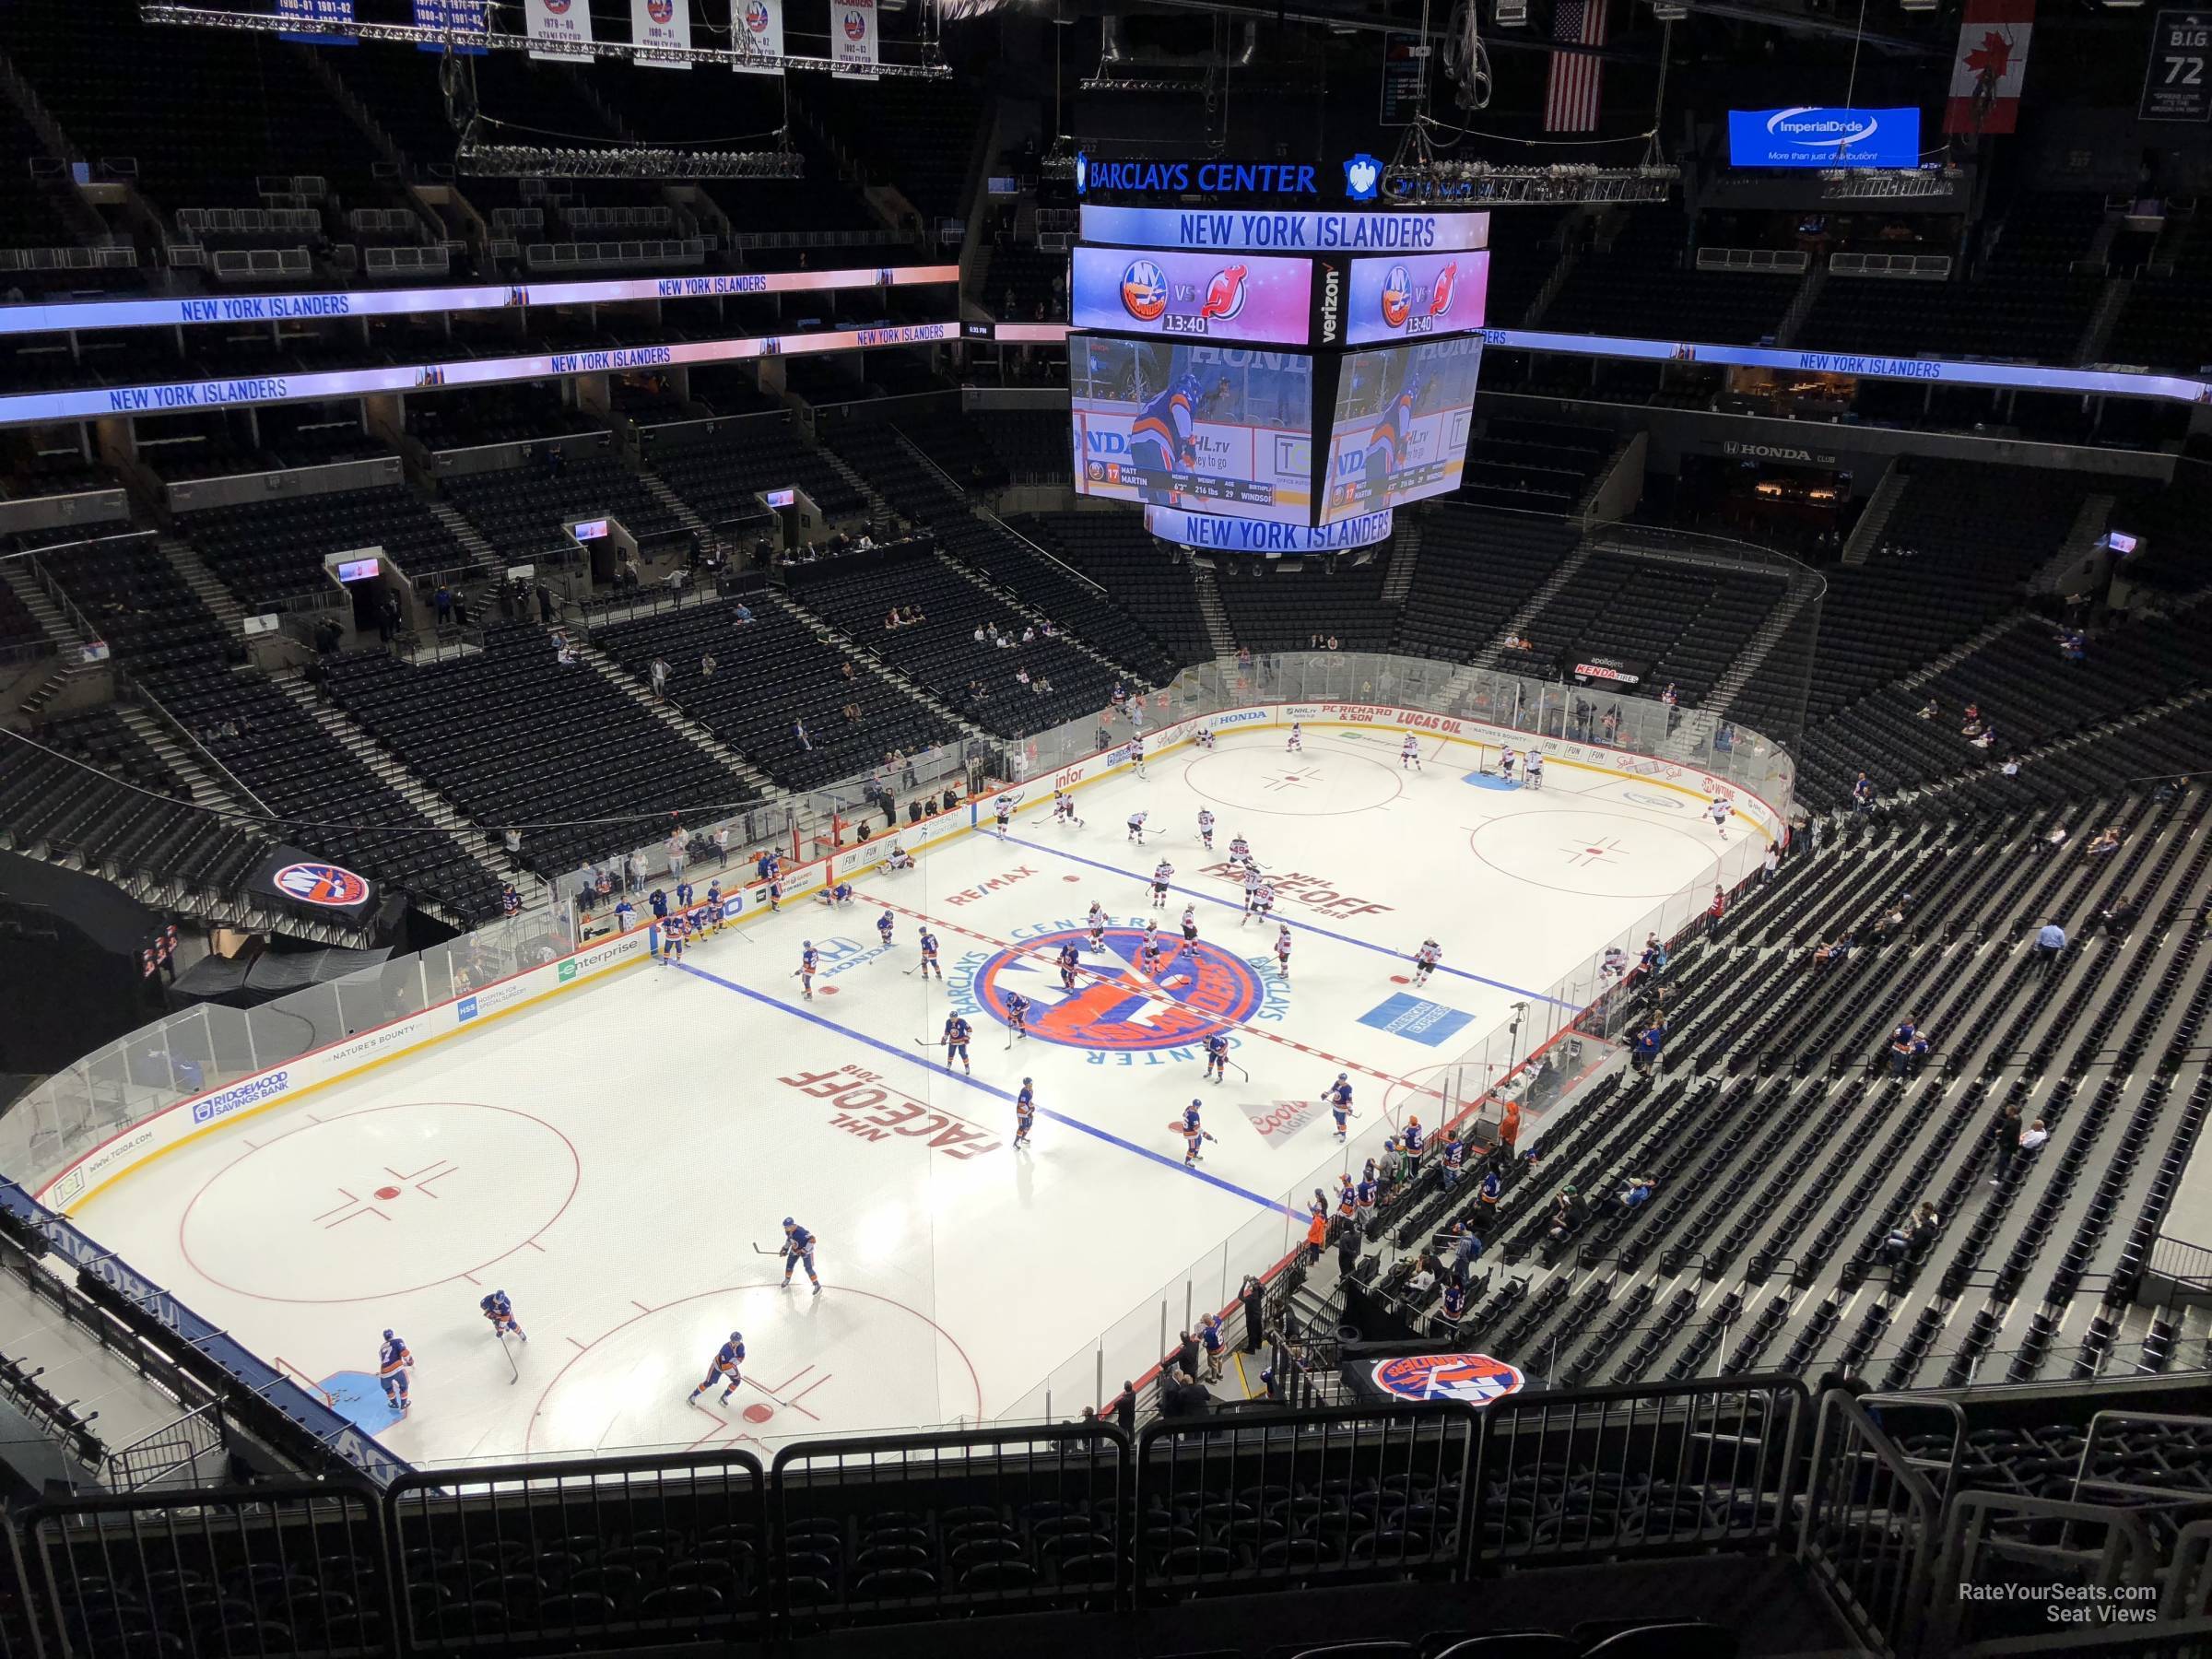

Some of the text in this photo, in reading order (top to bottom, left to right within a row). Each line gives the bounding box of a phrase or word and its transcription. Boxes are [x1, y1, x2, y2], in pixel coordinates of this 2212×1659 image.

[2165, 56, 2204, 84] 72
[1768, 151, 1827, 161] More than just
[1090, 162, 1318, 194] BARCLAYS CENTER
[1181, 214, 1435, 247] NEW YORK ISLANDERS
[658, 276, 766, 296] NEW YORK ISLANDERS
[182, 295, 349, 321] NEW YORK ISLANDERS
[1324, 270, 1339, 344] verizon
[1166, 315, 1206, 332] 13:40
[1408, 316, 1431, 332] 13:40
[857, 324, 944, 346] NEW YORK ISLANDERS
[551, 347, 670, 373] NEW YORK ISLANDERS
[1800, 354, 1941, 378] NEW YORK ISLANDERS
[110, 379, 287, 410] NEW YORK ISLANDERS
[1741, 444, 1812, 461] HONDA
[1108, 466, 1137, 479] 17 MATT
[1121, 475, 1147, 487] MARTIN
[1194, 486, 1206, 495] 216
[1225, 489, 1234, 499] 29
[1186, 511, 1389, 549] NEW YORK ISLANDERS
[1577, 665, 1638, 683] KENDA TIRES
[1219, 711, 1267, 724] HONDA
[1339, 705, 1392, 716] RICHARD
[1348, 713, 1373, 723] SON
[1396, 712, 1462, 734] LUCAS OIL
[1545, 741, 1557, 750] FUN
[1568, 746, 1581, 755] FUN
[1592, 750, 1605, 759] FUN
[1054, 767, 1084, 789] infor
[866, 847, 877, 860] FUN
[887, 838, 899, 851] FUN
[845, 854, 857, 866] FUN
[944, 865, 1040, 906] RE/MAX
[1285, 872, 1335, 888] NHL
[560, 939, 638, 975] enterprise
[818, 943, 900, 978] HONDA
[947, 950, 989, 1015] BARCLAYS
[1248, 956, 1290, 1022] BARCLAYS
[478, 989, 505, 1004] HOSPITAL
[461, 1003, 476, 1015] HSS
[1383, 1001, 1434, 1033] AMERICAN
[1406, 1005, 1452, 1033] EXPRESS
[379, 1024, 415, 1043] BOUNTY
[1086, 1036, 1241, 1066] CNTER
[841, 1065, 885, 1083] 2018
[214, 1070, 288, 1107] RIDGEWOOD
[215, 1081, 289, 1116] SAVINGS BANK
[777, 1070, 1003, 1159] FACE-OFF
[1250, 1100, 1308, 1135] Coors
[1277, 1110, 1315, 1135] LIGHT
[828, 1112, 891, 1143] NHL
